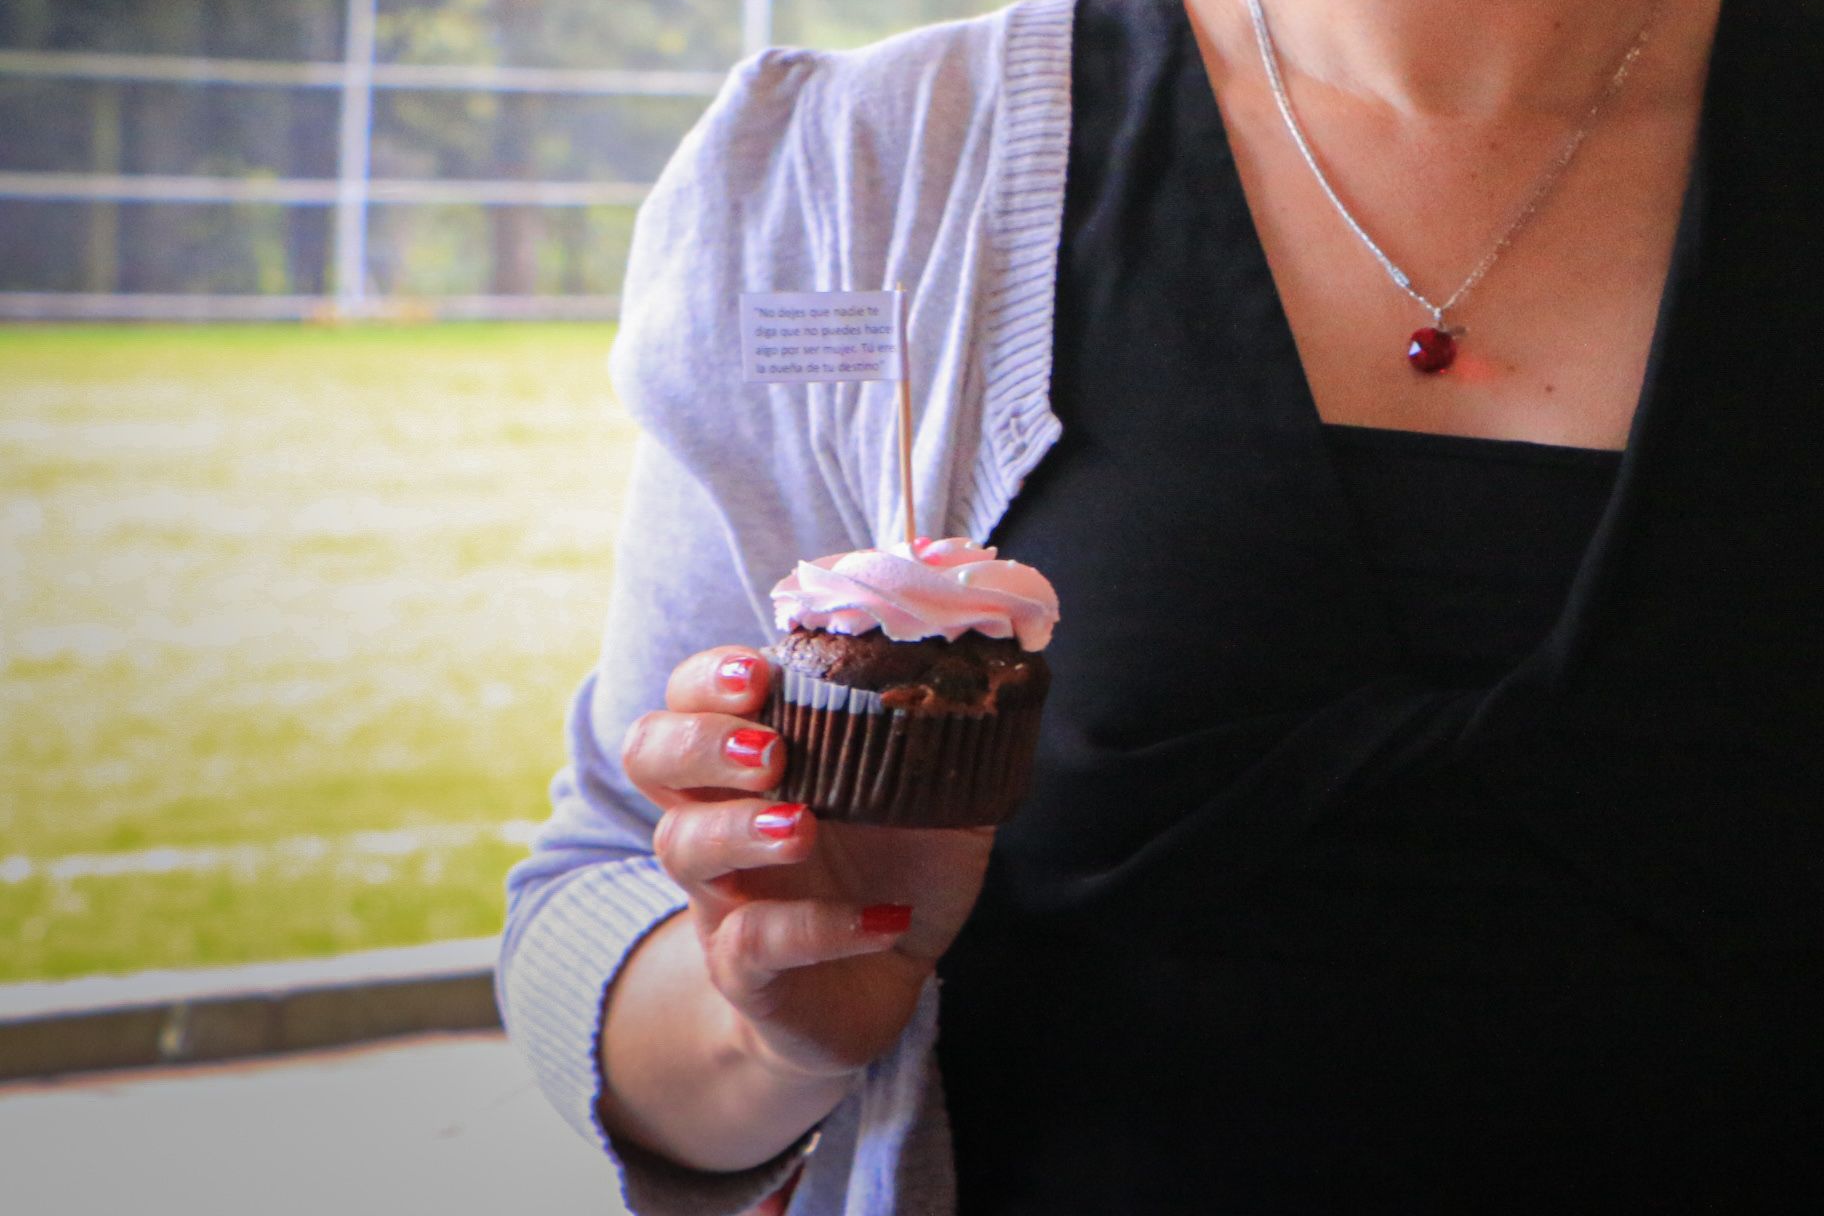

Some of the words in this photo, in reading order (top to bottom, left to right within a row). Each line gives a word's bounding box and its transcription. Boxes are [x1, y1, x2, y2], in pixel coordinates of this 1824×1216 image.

[778, 307, 805, 320] dejes
[811, 308, 829, 319] que
[834, 307, 864, 317] nadie
[868, 307, 880, 316] te
[756, 326, 777, 339] diga
[780, 328, 800, 337] que
[805, 328, 818, 336] no
[822, 325, 861, 338] puedes
[757, 346, 778, 358] algo
[782, 347, 799, 357] por
[757, 363, 766, 373] la
[769, 362, 803, 373] dueña
[808, 363, 820, 372] de
[823, 363, 834, 372] tu
